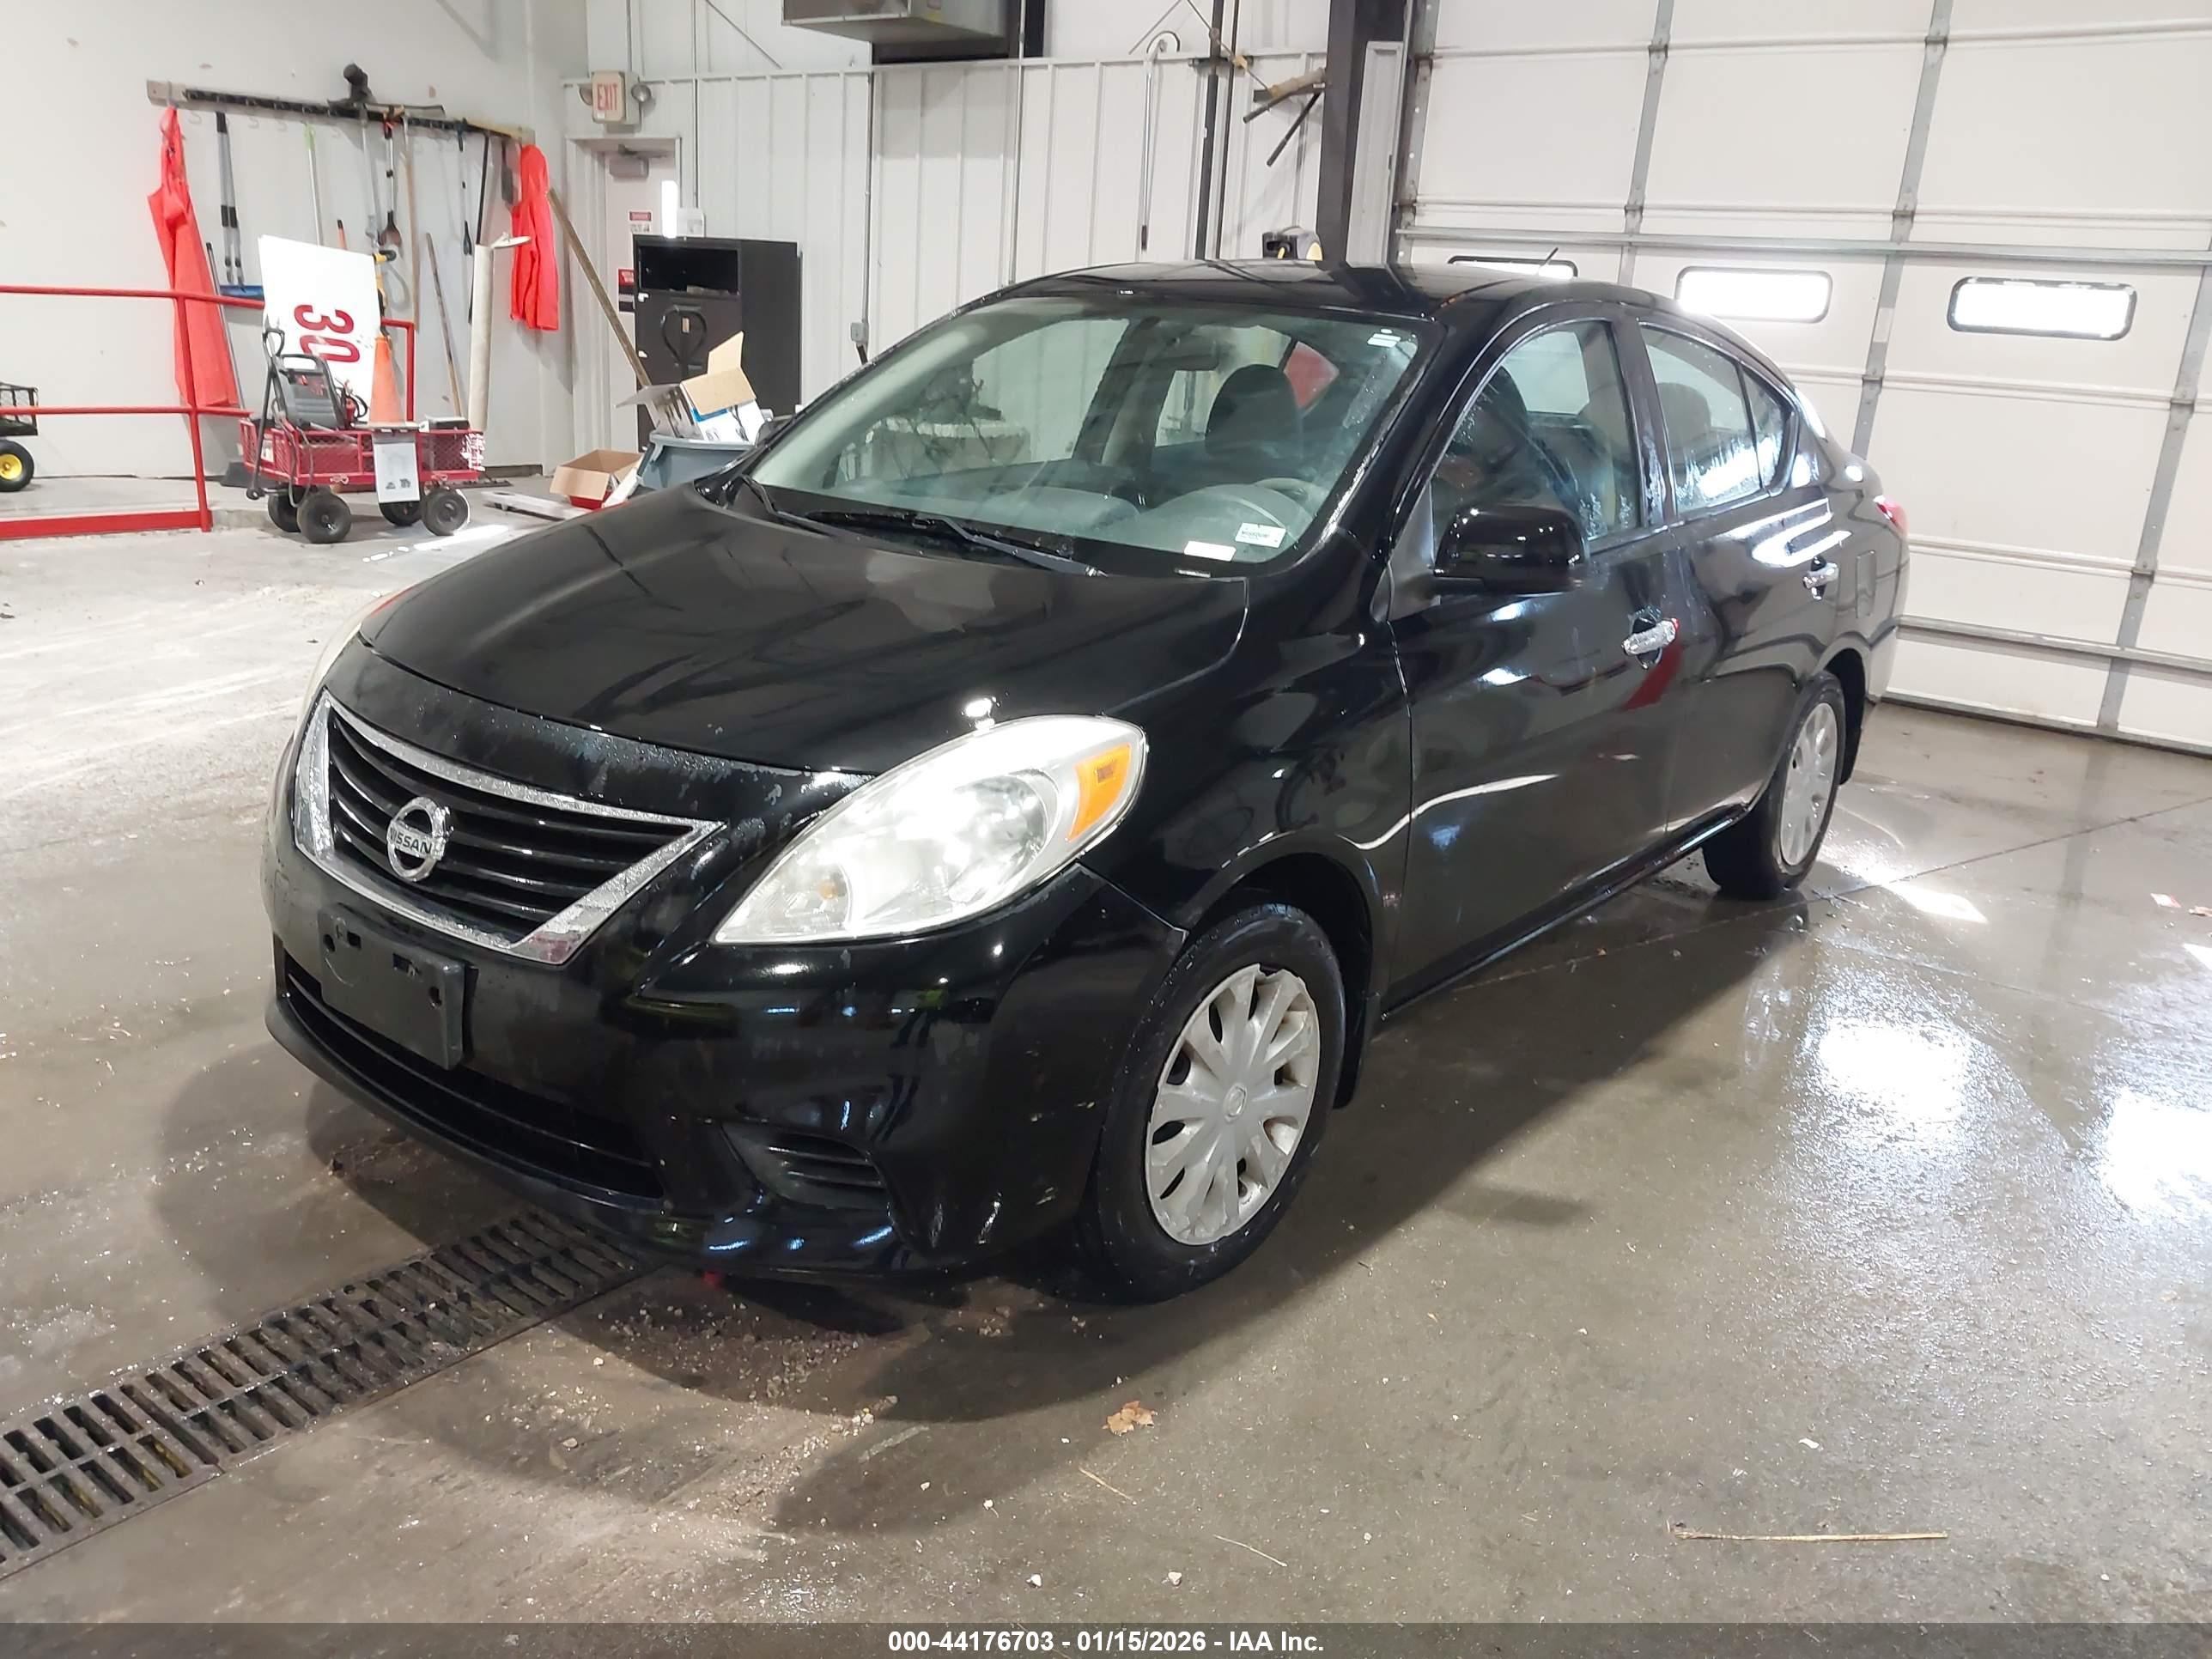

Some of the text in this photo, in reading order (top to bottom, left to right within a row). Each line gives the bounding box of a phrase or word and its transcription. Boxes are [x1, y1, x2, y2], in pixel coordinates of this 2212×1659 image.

[597, 82, 617, 110] EXIT
[295, 304, 360, 362] 30
[390, 827, 432, 854] NISSAN
